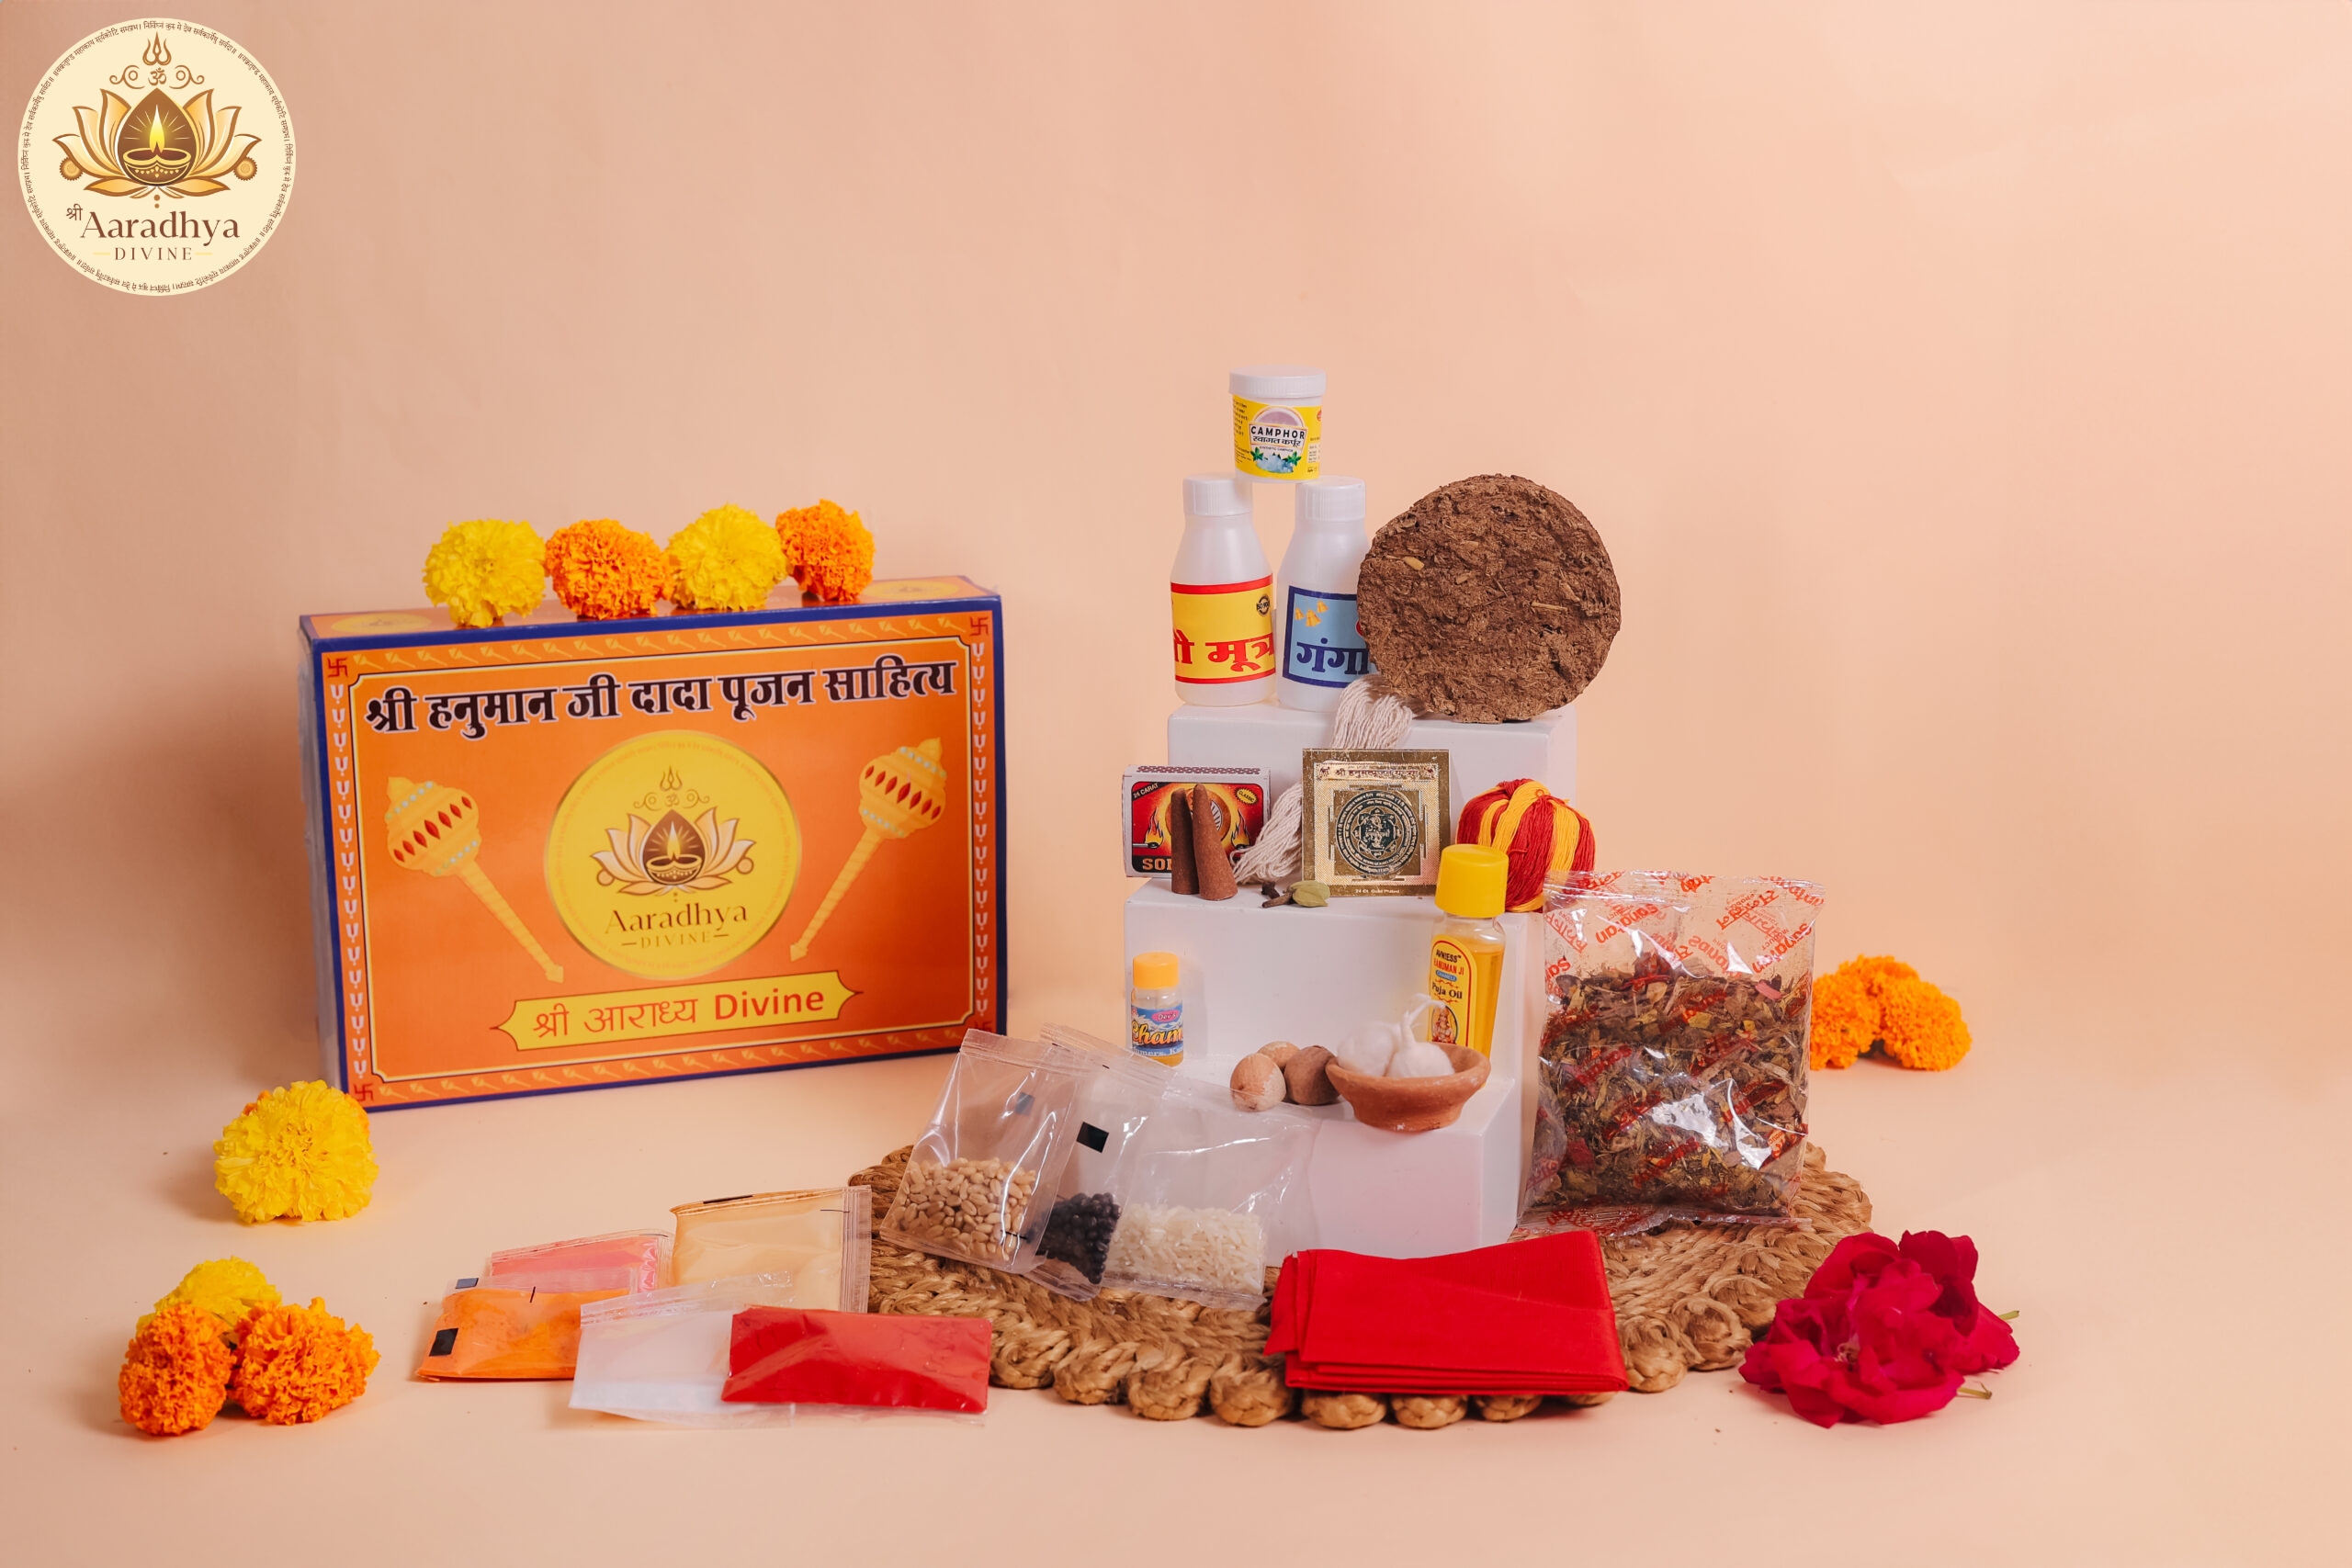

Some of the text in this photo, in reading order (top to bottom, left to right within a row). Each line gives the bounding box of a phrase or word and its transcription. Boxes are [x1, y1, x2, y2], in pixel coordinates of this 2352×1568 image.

[1251, 426, 1305, 439] CAMPHOR
[365, 654, 958, 739] श्री हनुमान जी दादा पूजन साहित्य
[1140, 783, 1158, 795] CARAT
[605, 901, 747, 935] Aaradhya
[640, 931, 711, 949] DIVINE
[1458, 967, 1464, 975] JI
[1432, 981, 1462, 999] Puja Oil
[533, 987, 825, 1037] श्री आराध्य Divine
[1158, 1011, 1176, 1021] Dev's
